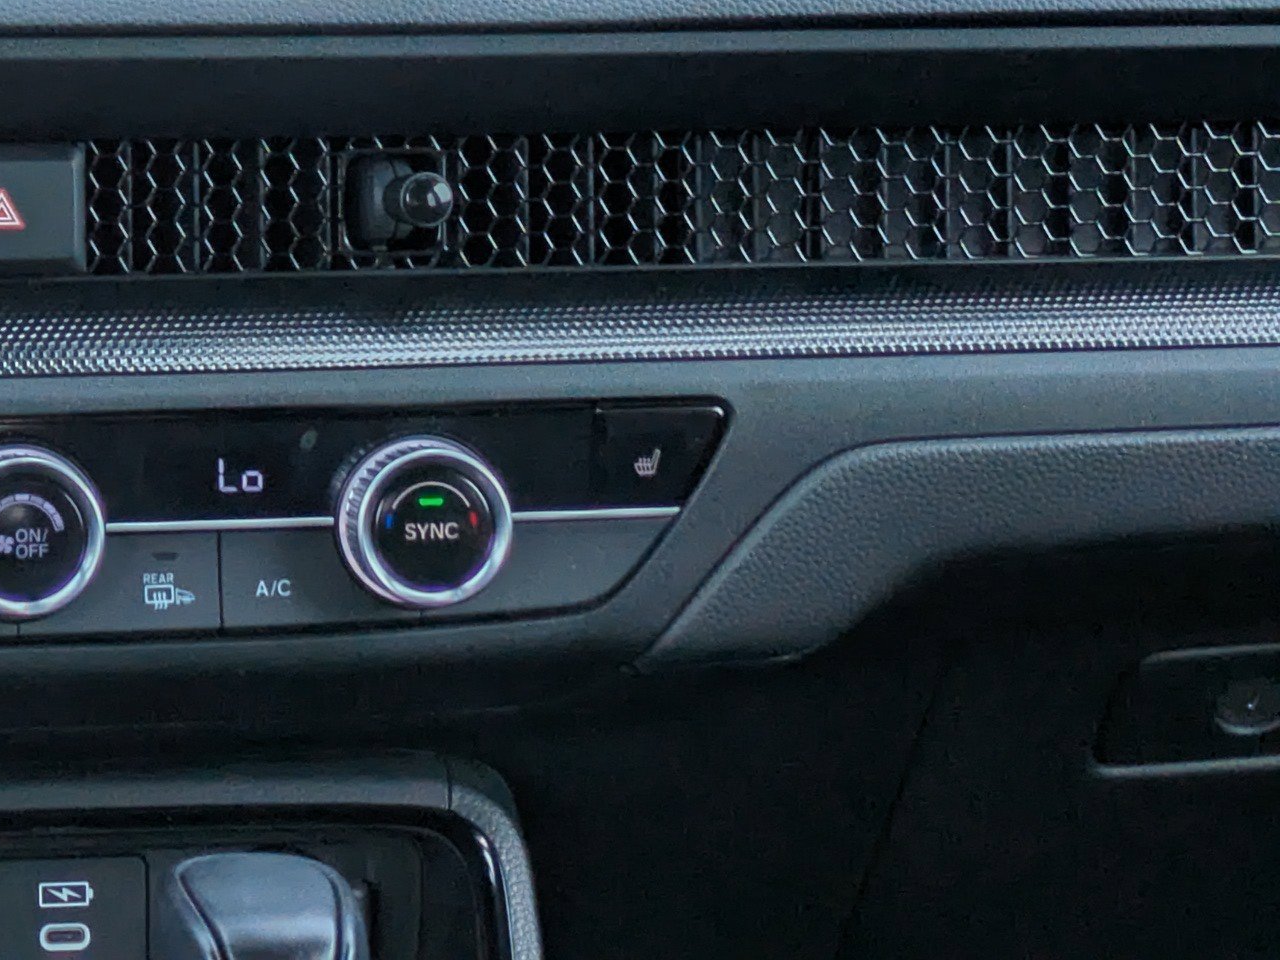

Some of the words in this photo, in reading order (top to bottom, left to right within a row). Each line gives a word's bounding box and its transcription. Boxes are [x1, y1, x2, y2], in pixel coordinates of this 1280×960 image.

[217, 457, 264, 493] Lo
[404, 521, 460, 542] SYNC
[15, 543, 50, 559] OFF
[142, 572, 175, 585] REAR
[255, 579, 292, 597] A/C
